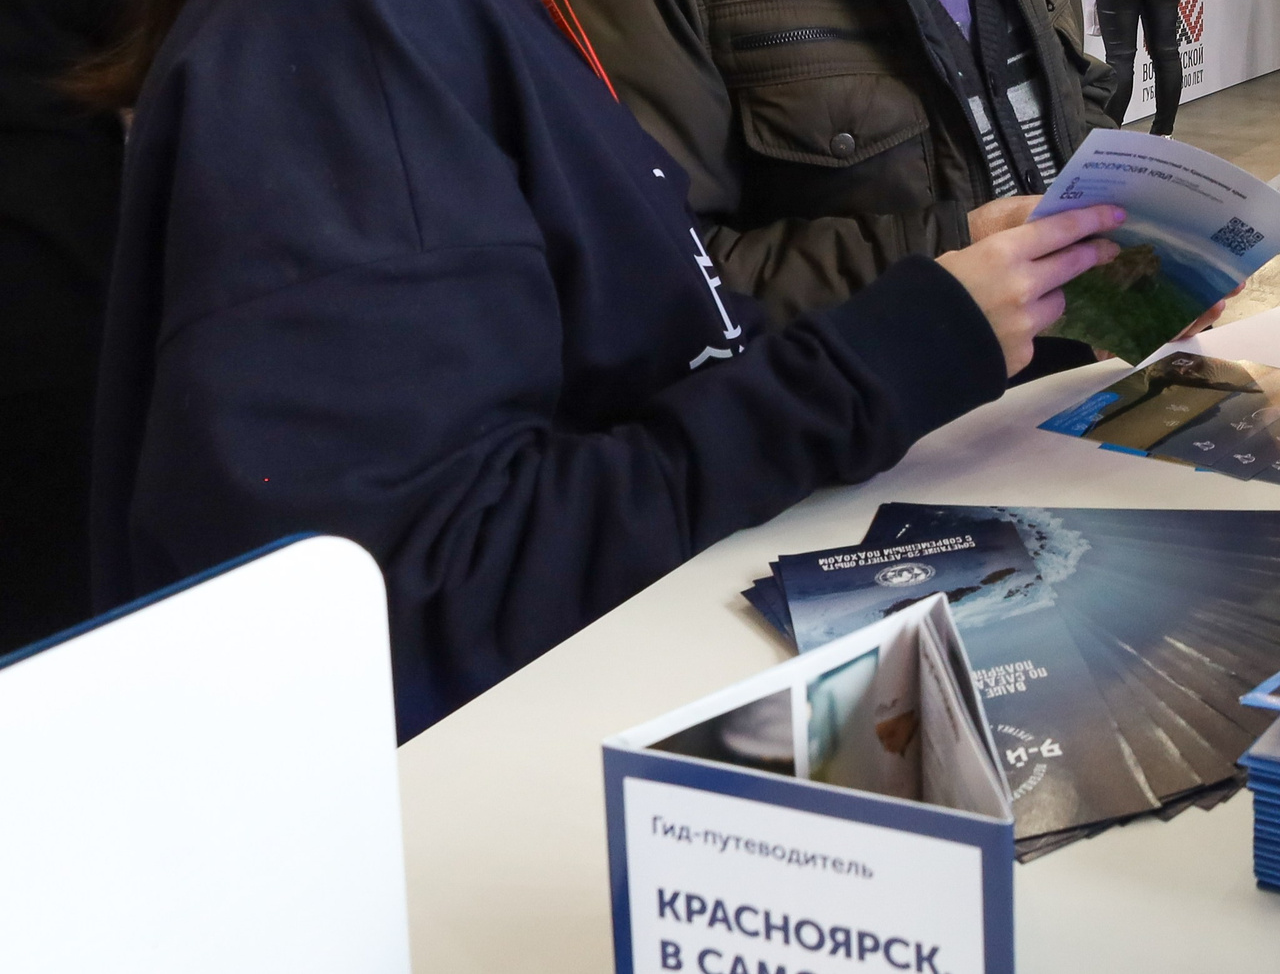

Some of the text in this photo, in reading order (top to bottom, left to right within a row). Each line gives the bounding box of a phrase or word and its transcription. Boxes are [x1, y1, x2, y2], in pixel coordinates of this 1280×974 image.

[1192, 70, 1204, 86] ЛЕТ
[818, 551, 881, 566] ПОДХОДОМ
[974, 667, 1048, 690] ПО СЛЕДА
[985, 681, 1027, 699] ВАШЕ
[651, 815, 875, 879] Гид-путеводитель
[660, 939, 683, 971] В
